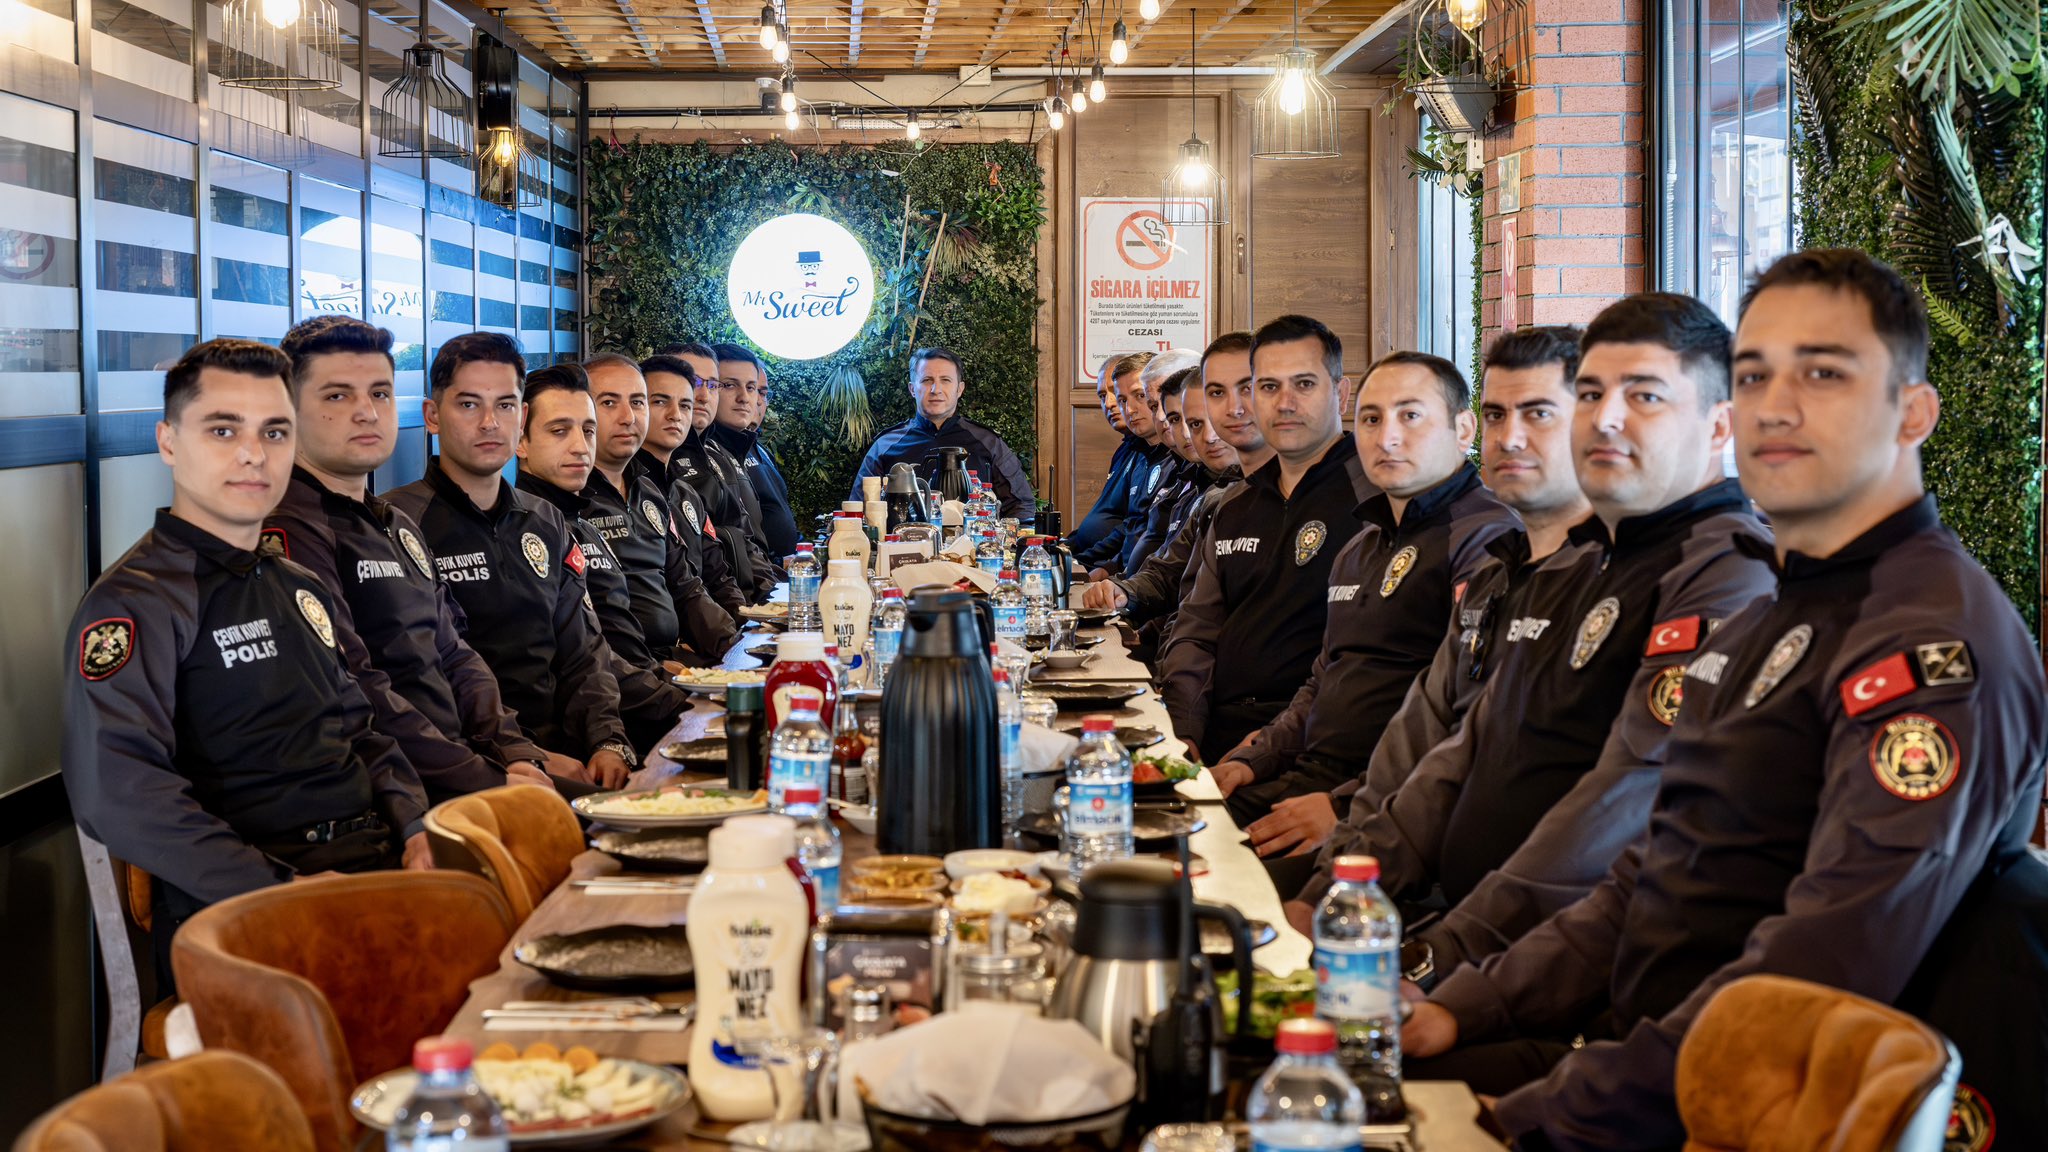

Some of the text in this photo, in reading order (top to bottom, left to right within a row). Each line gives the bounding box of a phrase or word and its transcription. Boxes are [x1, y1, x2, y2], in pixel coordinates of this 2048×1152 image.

[1090, 275, 1200, 301] SİGARA İÇİLMEZ
[764, 276, 859, 320] Sweet
[1128, 328, 1163, 336] CEZASI
[435, 555, 457, 571] EVİK
[833, 623, 855, 636] MAYO
[837, 635, 852, 648] NEZ
